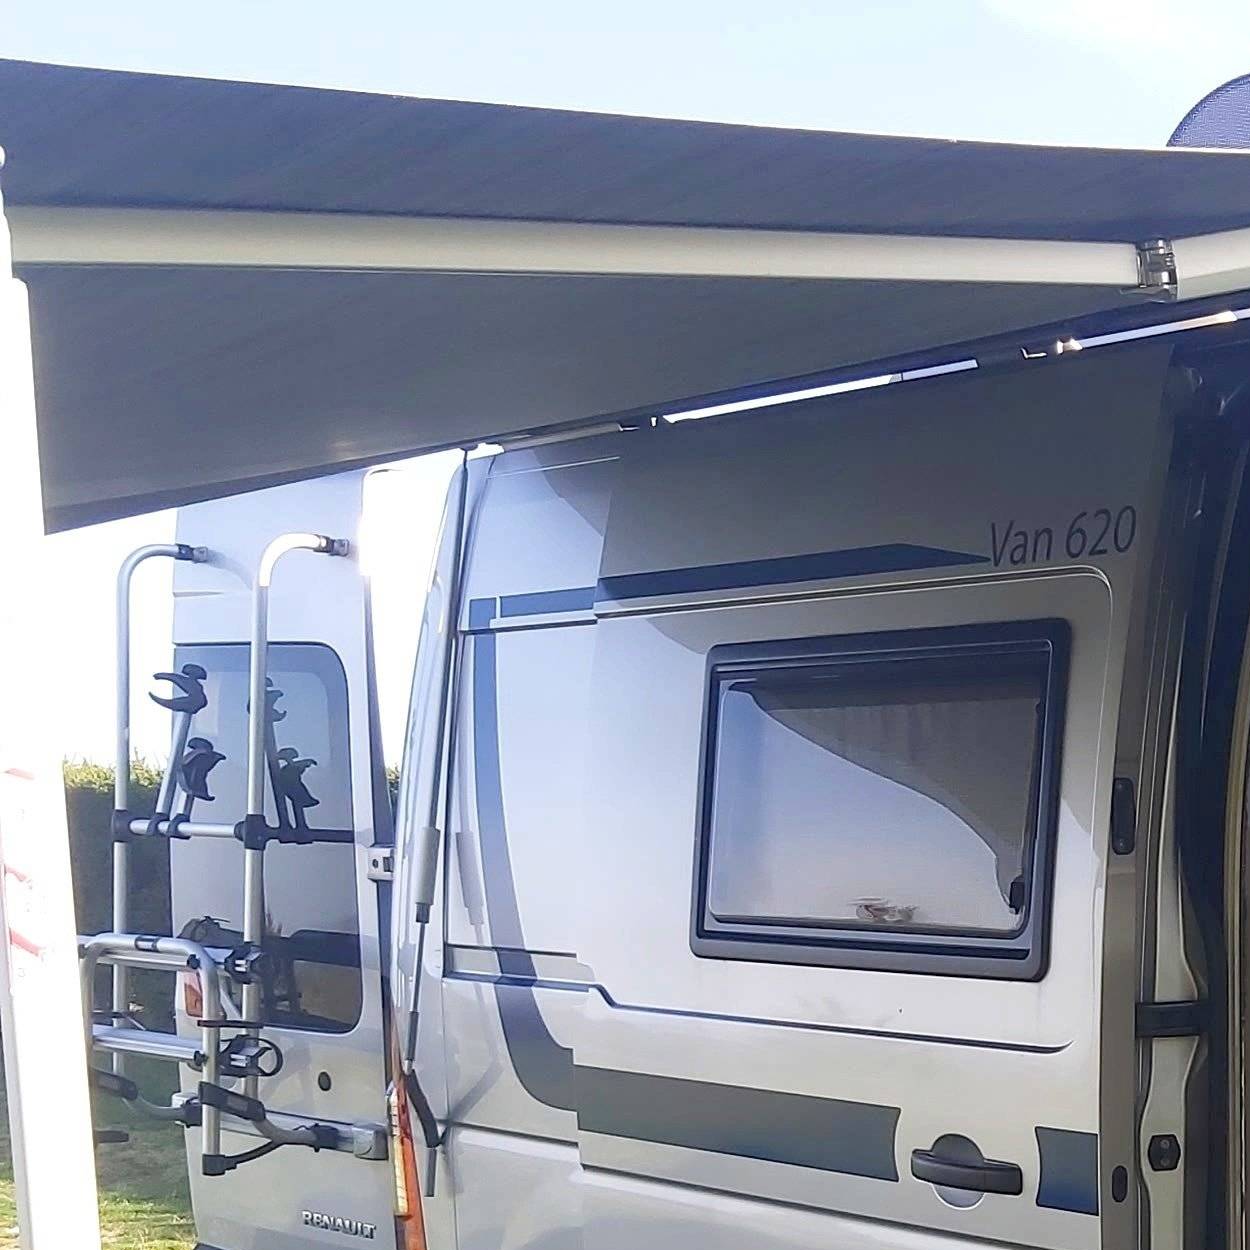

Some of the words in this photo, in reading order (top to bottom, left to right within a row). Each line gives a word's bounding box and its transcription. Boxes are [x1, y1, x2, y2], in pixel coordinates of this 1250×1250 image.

[991, 519, 1053, 567] Van
[1065, 505, 1137, 559] 620
[301, 1209, 376, 1239] RENAULT
